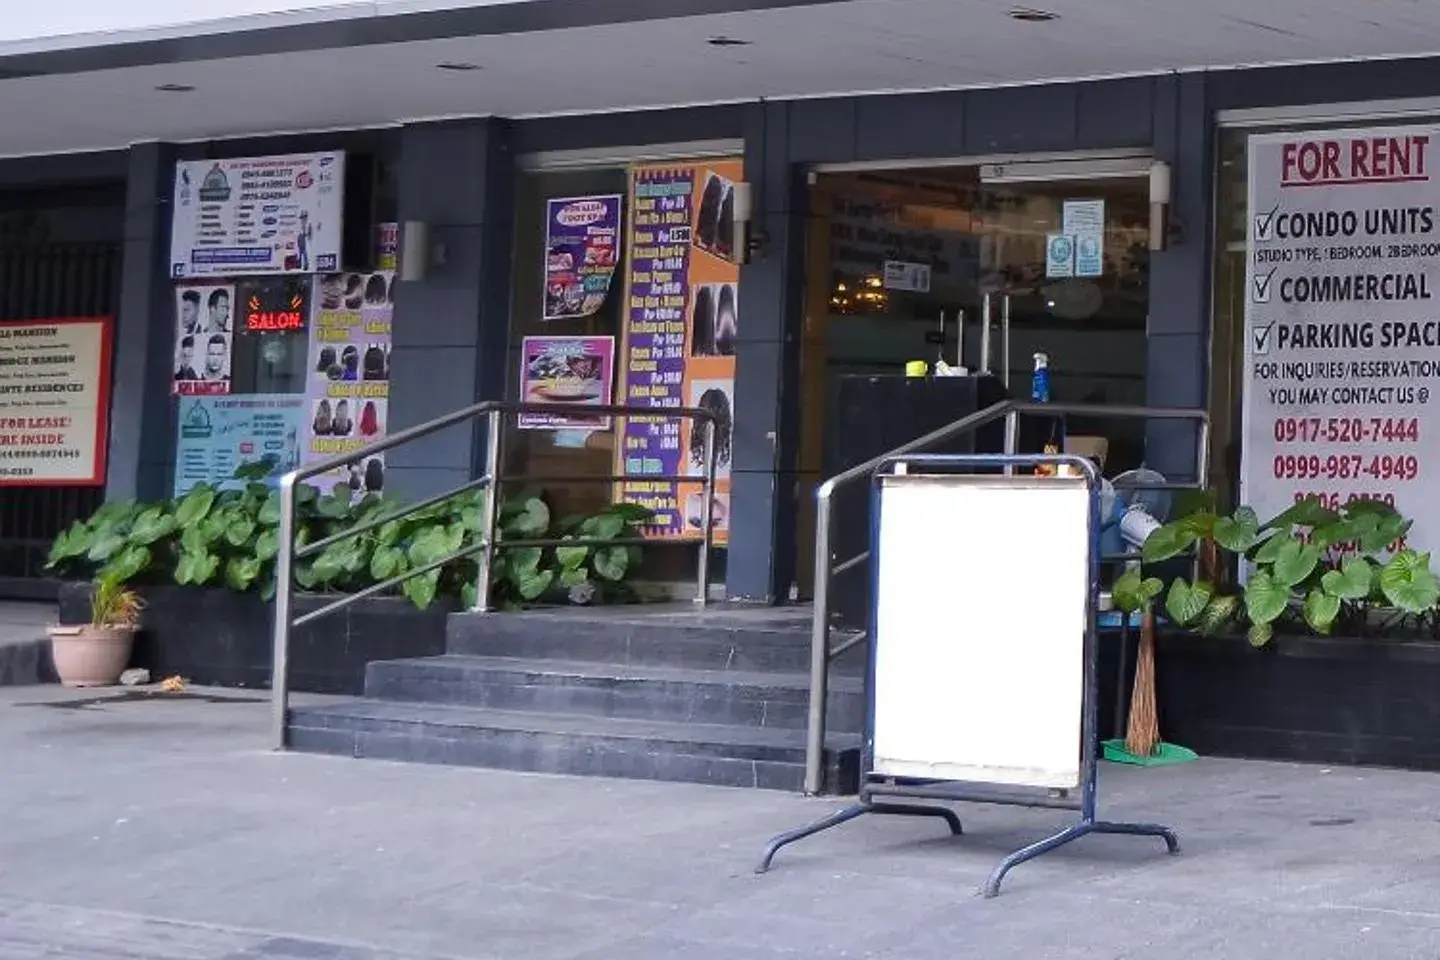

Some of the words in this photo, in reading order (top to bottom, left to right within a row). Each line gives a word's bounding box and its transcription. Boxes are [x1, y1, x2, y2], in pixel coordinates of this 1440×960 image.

[1281, 140, 1342, 181] FOR
[1351, 136, 1430, 178] RENT
[1275, 211, 1358, 239] CONDO
[1364, 207, 1433, 236] UNITS
[1279, 273, 1432, 303] COMMERCIAL
[1277, 323, 1374, 349] PARKING
[1253, 363, 1278, 380] FOR
[1269, 388, 1295, 405] YOU
[1299, 387, 1329, 405] MAY
[1331, 387, 1393, 405] CONTACT
[1397, 387, 1414, 404] US
[1274, 417, 1419, 442] 0917-520-7444
[1274, 455, 1419, 480] 0999-987-4949
